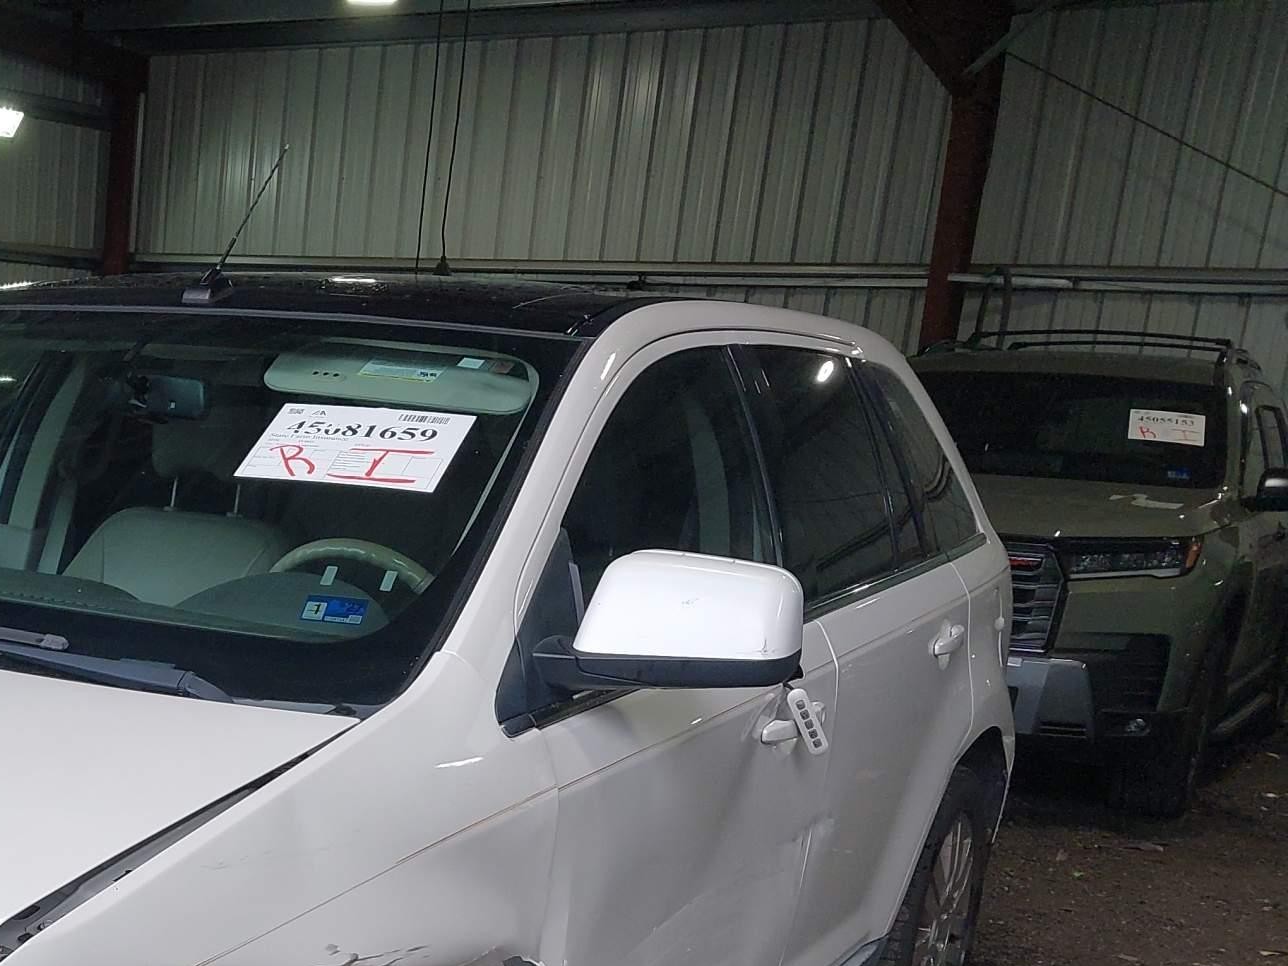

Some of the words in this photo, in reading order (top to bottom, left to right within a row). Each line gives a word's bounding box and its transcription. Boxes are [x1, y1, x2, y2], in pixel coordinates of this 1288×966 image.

[286, 420, 439, 442] 45081659
[269, 444, 316, 477] R
[326, 447, 435, 484] I
